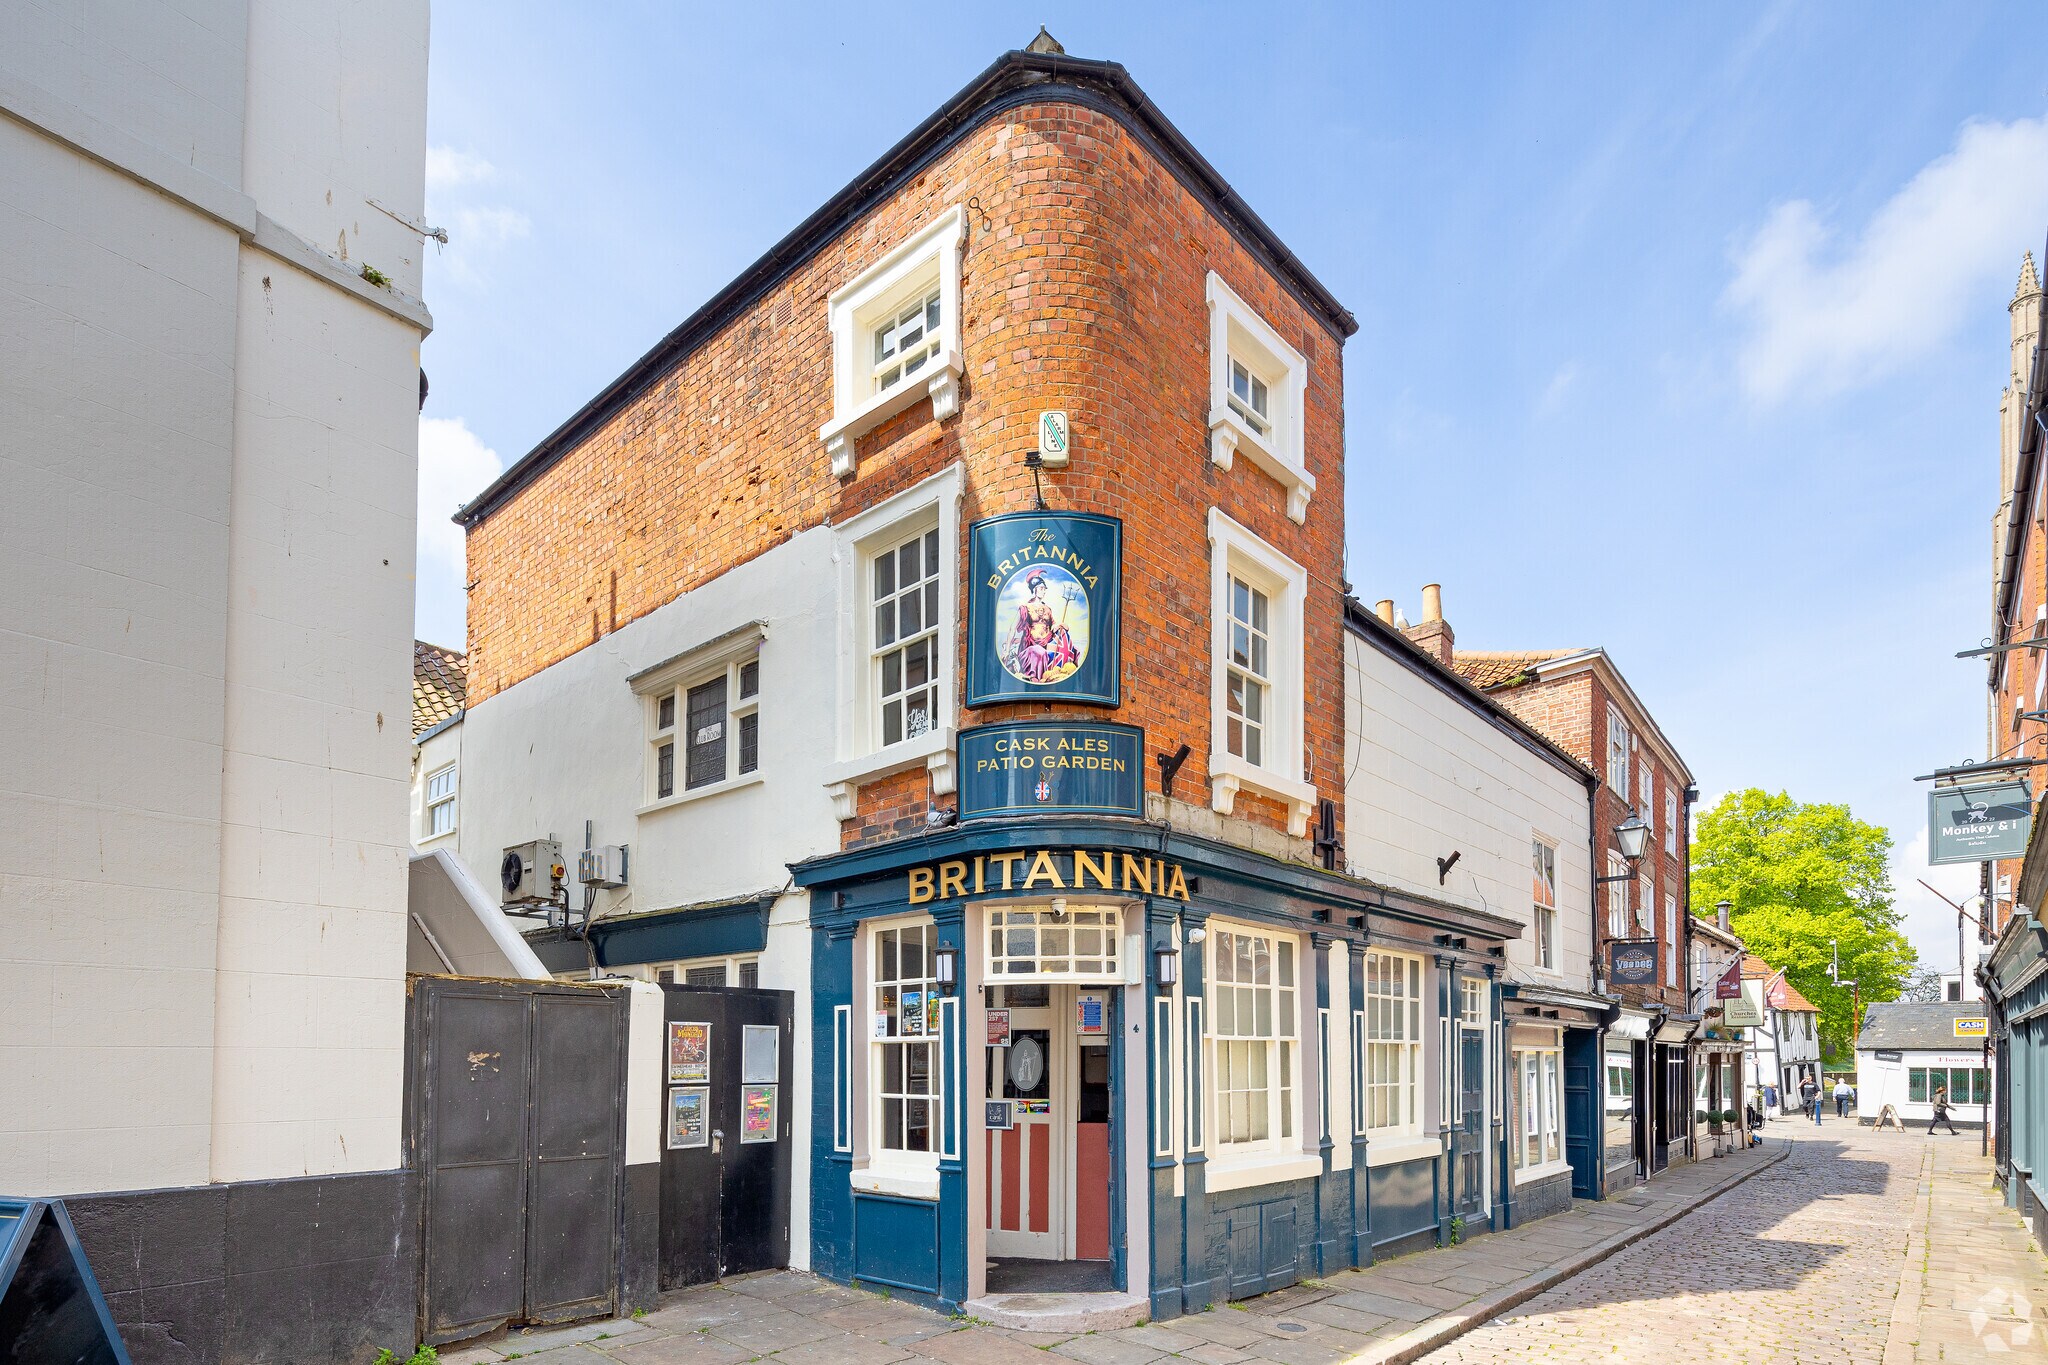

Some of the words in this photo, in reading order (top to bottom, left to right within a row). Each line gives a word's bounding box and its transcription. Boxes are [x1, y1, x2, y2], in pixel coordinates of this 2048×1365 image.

[1028, 528, 1057, 542] The
[987, 544, 1099, 590] BRITANNIA
[995, 738, 1050, 752] CASK
[1057, 738, 1109, 752] ALES
[977, 756, 1035, 773] PATIO
[1041, 756, 1125, 772] GARDEN
[1942, 824, 1994, 836] Monkey
[1998, 820, 2009, 831] &
[908, 850, 1190, 905] BRITANNIA
